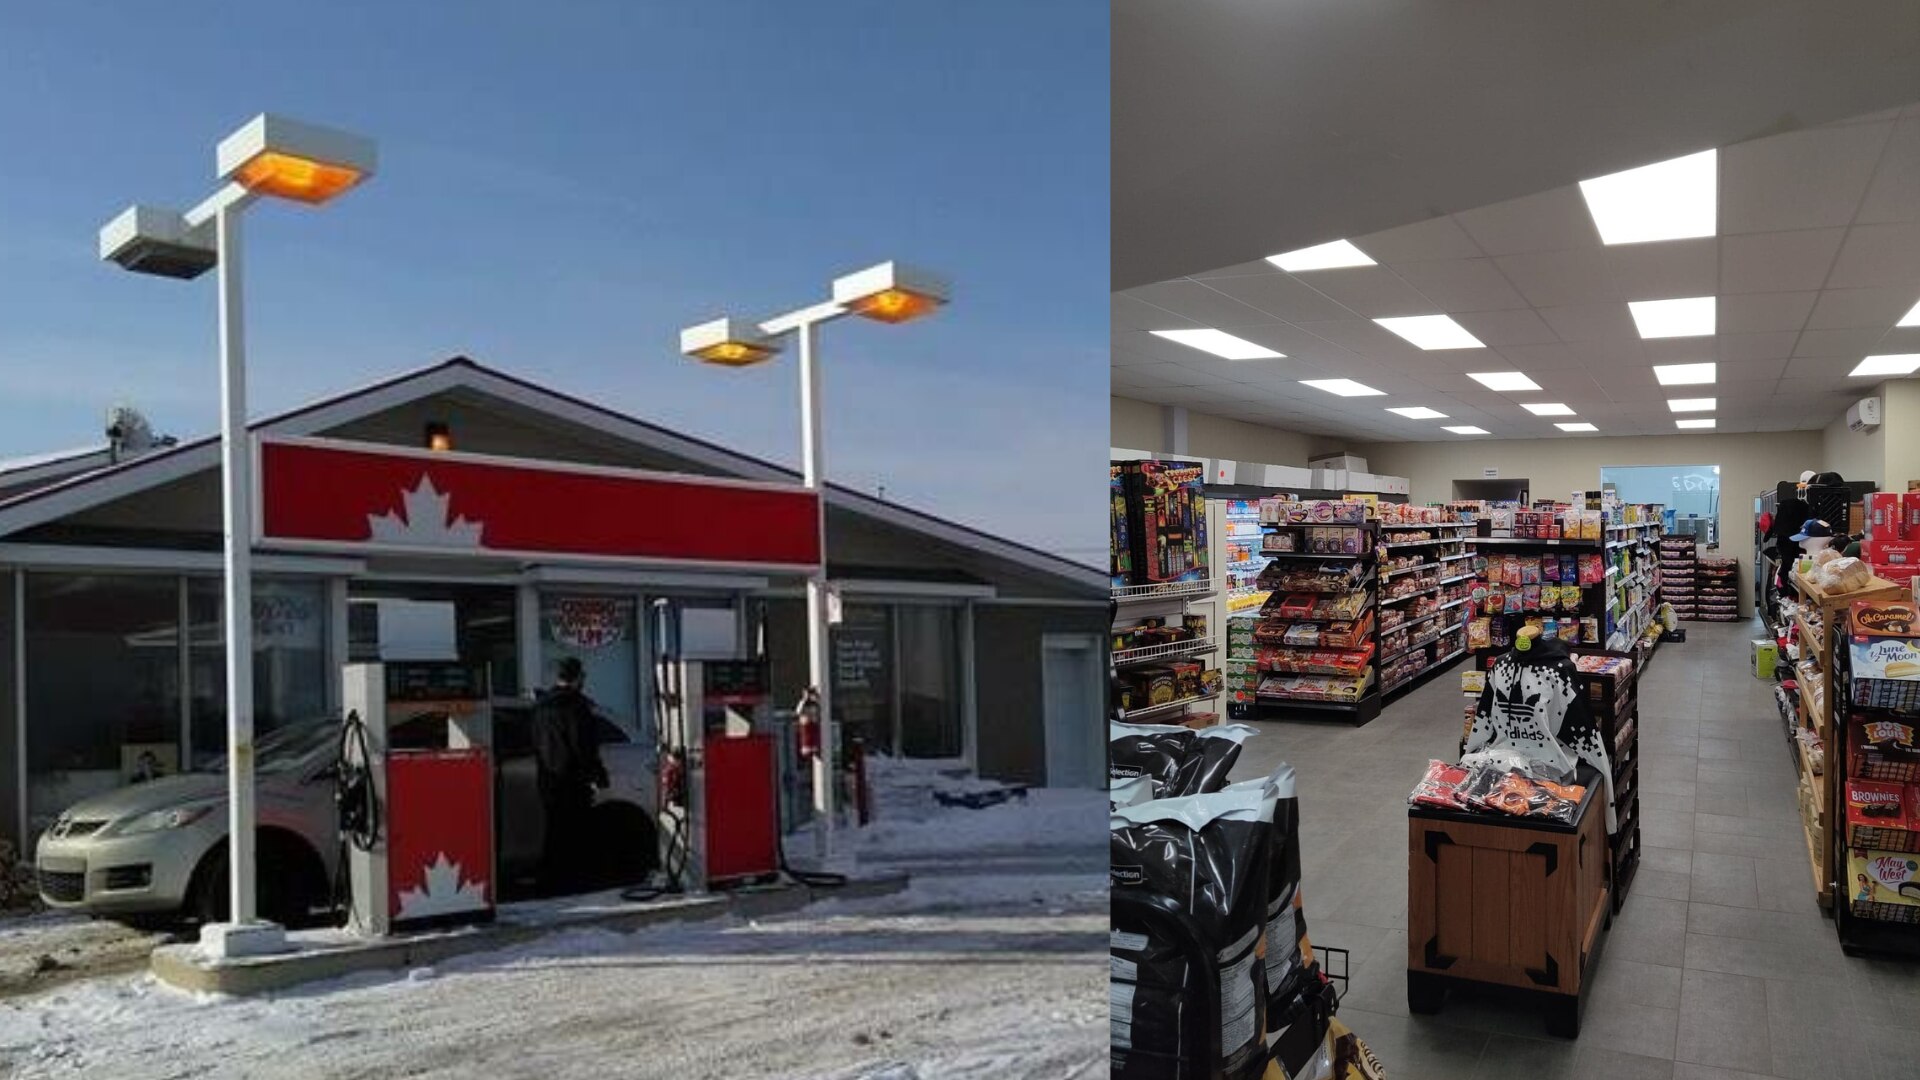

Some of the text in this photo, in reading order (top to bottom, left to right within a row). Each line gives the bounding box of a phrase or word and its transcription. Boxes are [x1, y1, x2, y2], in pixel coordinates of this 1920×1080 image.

[1886, 503, 1894, 533] Budweiser
[1880, 544, 1914, 552] Budweiser
[1880, 645, 1905, 656] Lune
[1886, 652, 1917, 662] Moon
[1873, 729, 1906, 740] LOUIS
[1875, 856, 1905, 871] May
[1879, 868, 1907, 881] West
